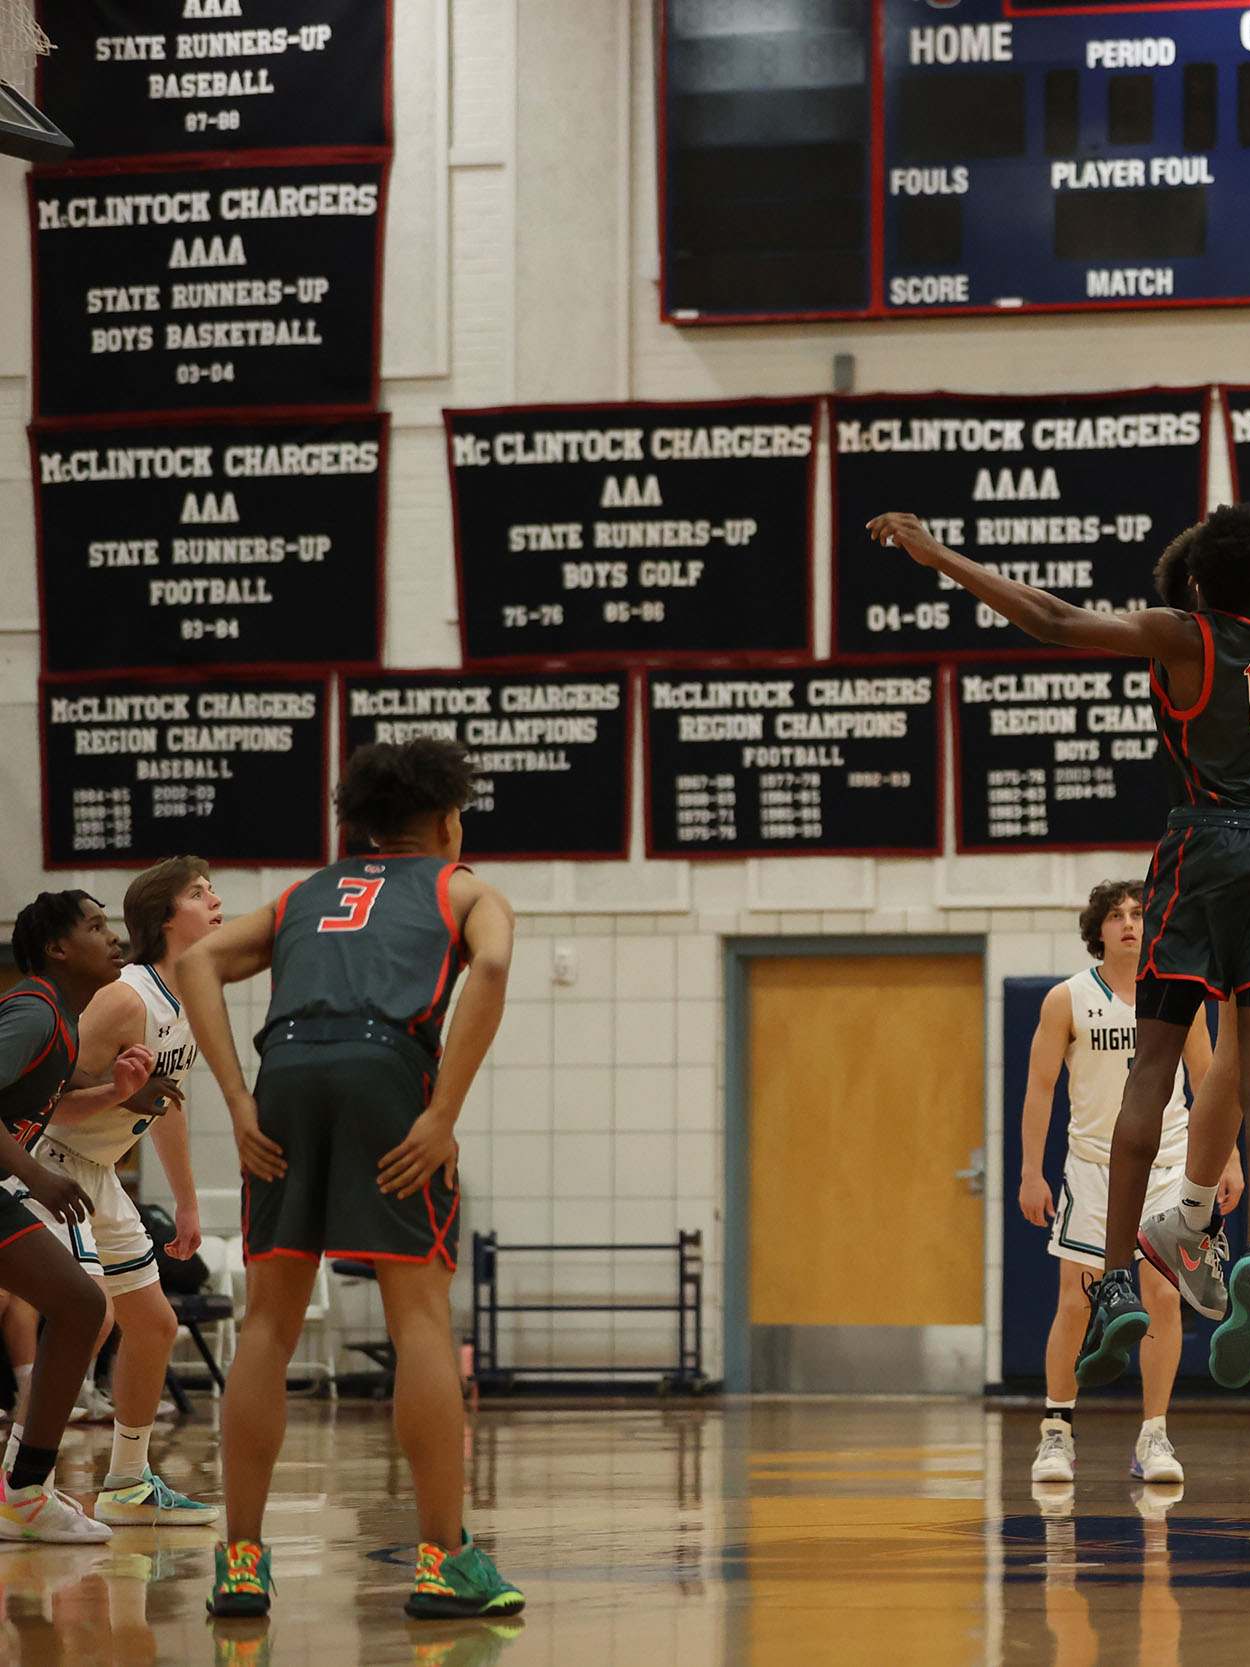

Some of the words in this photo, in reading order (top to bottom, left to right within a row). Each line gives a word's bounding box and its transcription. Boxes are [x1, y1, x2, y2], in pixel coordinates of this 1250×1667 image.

[97, 36, 165, 60] STATE
[177, 24, 331, 58] RUNNERS-UP
[910, 23, 1012, 64] HOME
[1087, 38, 1175, 68] PERIOD
[150, 69, 274, 98] BASEBALL
[891, 167, 968, 195] FOULS
[1052, 159, 1145, 189] PLAYER
[1151, 157, 1214, 185] FOUL
[39, 192, 210, 229] McCLINTOCK
[221, 185, 377, 219] CHARGERS
[169, 235, 246, 268] AAAA
[88, 286, 160, 313] STATE
[173, 278, 329, 308] RUNNERS-UP
[891, 275, 968, 304] SCORE
[1087, 268, 1173, 297] MATCH
[92, 326, 153, 353] BOYS
[166, 320, 322, 349] BASKETBALL
[453, 429, 643, 466] McCLINTOCK
[652, 426, 812, 459] CHARGERS
[838, 420, 1024, 452] McCLINTOCK
[1033, 413, 1200, 450] CHARGERS
[41, 447, 212, 483] McCLINTOCK
[225, 443, 378, 476] CHARGERS
[602, 476, 662, 507] AAA
[974, 468, 1060, 500] AAAA
[181, 493, 239, 523] AAA
[510, 524, 582, 551] STATE
[595, 519, 756, 548] RUNNERS-UP
[977, 516, 1151, 544] RUNNERS-UP
[89, 540, 158, 567] STATE
[173, 536, 330, 563] RUNNERS-UP
[563, 562, 627, 589] BOYS
[641, 561, 704, 586] GOLF
[150, 578, 272, 605] FOOTBALL
[868, 603, 949, 631] 04-05
[352, 688, 491, 715] McCLINTOCK
[501, 684, 619, 711] CHARGERS
[653, 682, 793, 708] McCLINTOCK
[808, 678, 931, 705] CHARGERS
[963, 673, 1111, 702] McCLINTOCK
[52, 695, 189, 722] McCLINTOCK
[198, 694, 315, 718] CHARGERS
[991, 707, 1076, 735] REGION
[76, 728, 157, 754] REGION
[167, 726, 292, 751] CHAMPIONS
[466, 717, 597, 744] CHAMPIONS
[680, 714, 763, 741] REGION
[776, 712, 907, 739] CHAMPIONS
[467, 750, 571, 773] ASKETBALL
[743, 746, 844, 767] FOOTBALL
[1112, 739, 1158, 760] GOLF
[137, 759, 232, 779] BASEBALL
[317, 877, 385, 934] 3
[1091, 1027, 1137, 1051] HIGH
